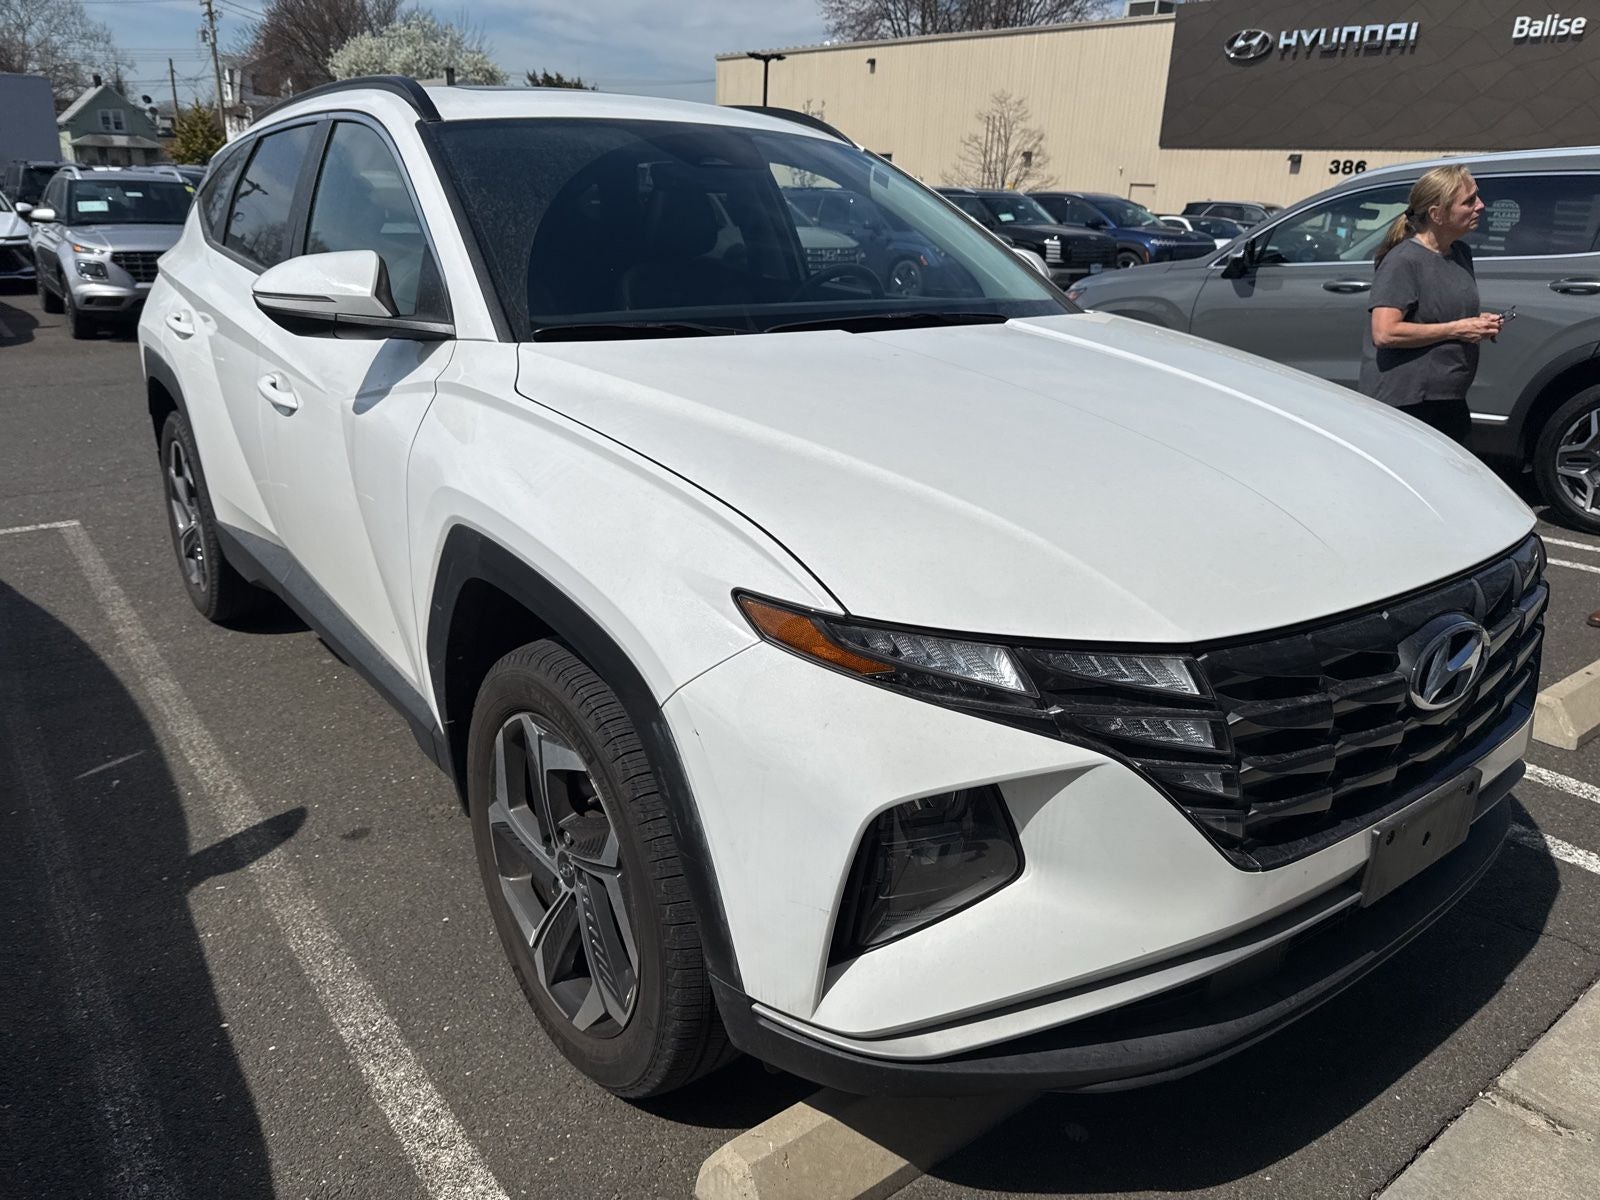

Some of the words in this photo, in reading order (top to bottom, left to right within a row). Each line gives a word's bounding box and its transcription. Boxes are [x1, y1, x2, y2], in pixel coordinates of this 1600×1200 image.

[1278, 21, 1419, 50] HYUNDAI
[1511, 12, 1588, 39] Balise
[1328, 159, 1367, 175] 386
